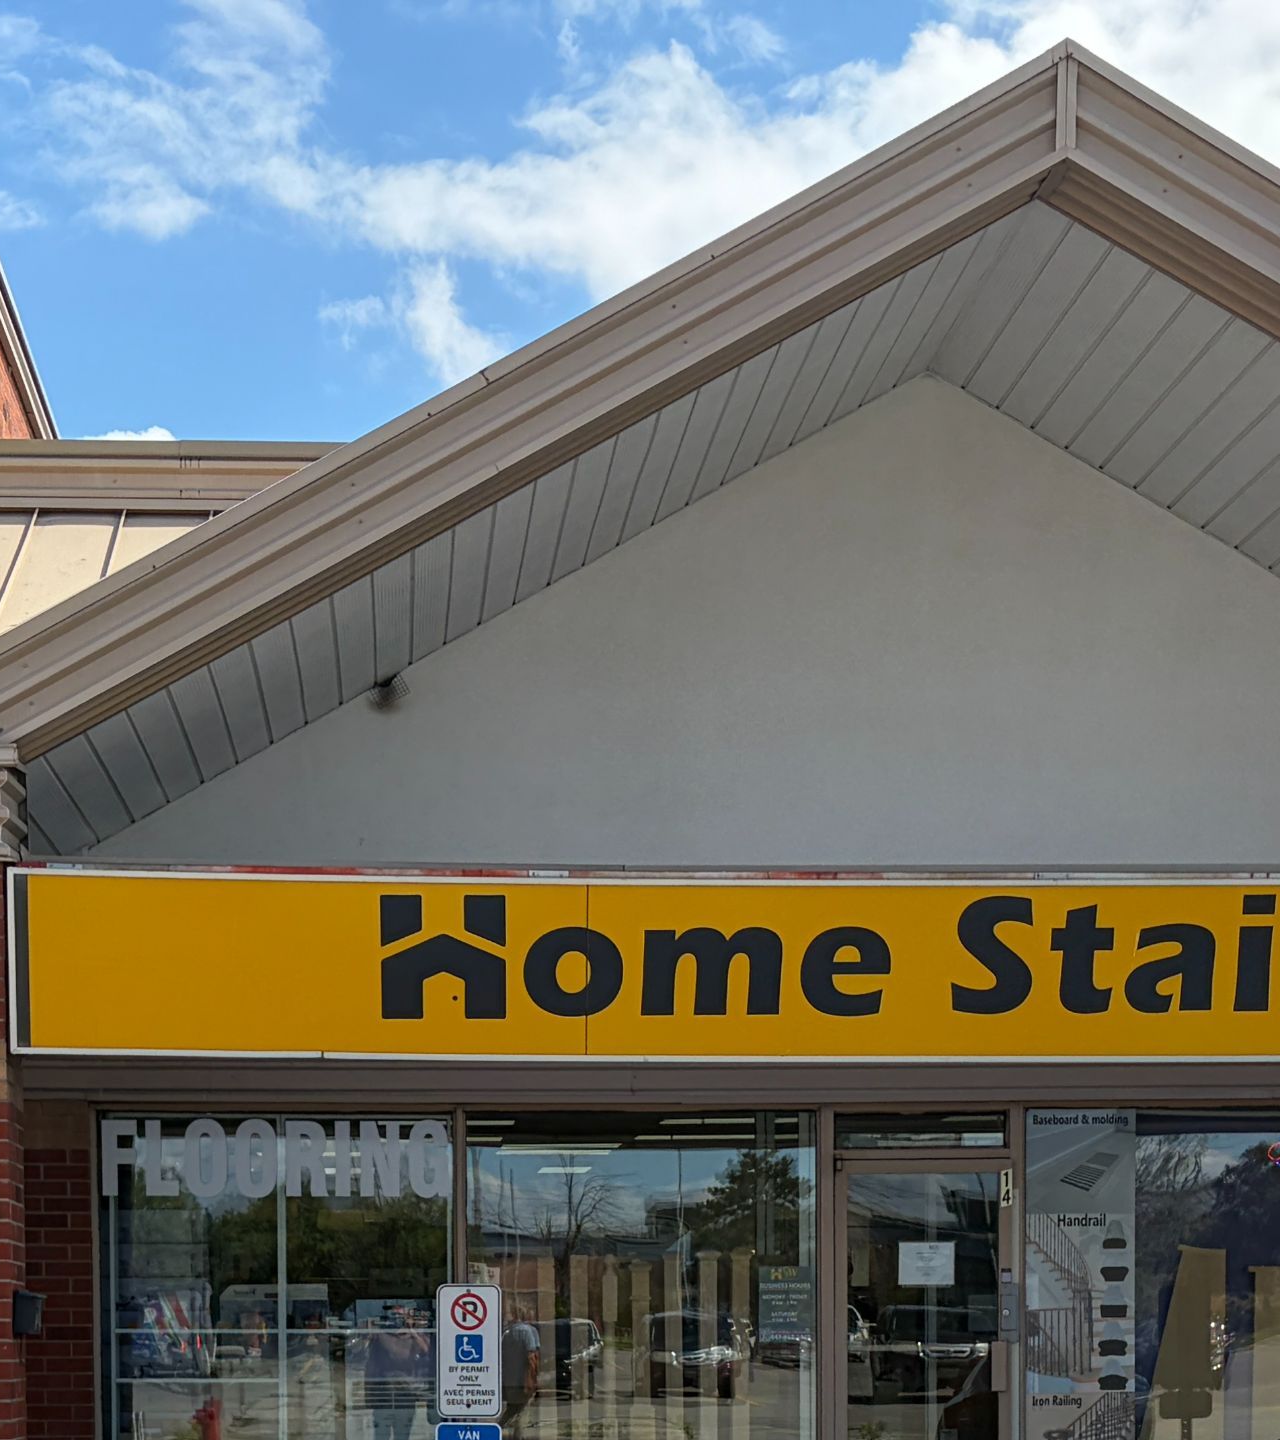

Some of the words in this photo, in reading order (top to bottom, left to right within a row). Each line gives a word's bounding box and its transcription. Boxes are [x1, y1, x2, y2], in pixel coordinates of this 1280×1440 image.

[380, 894, 891, 1020] Home
[1033, 1114, 1079, 1125] Baseboard
[1082, 1114, 1090, 1125] &
[1092, 1114, 1129, 1126] molding
[101, 1118, 453, 1199] FLOORING
[1057, 1213, 1107, 1227] Handrail
[460, 1365, 490, 1373] PERMIT
[443, 1389, 464, 1397] AVEC
[465, 1389, 496, 1397] PERMIS
[446, 1398, 493, 1406] SEULEMENT
[1032, 1396, 1051, 1406] Iron
[1052, 1395, 1082, 1408] Railing
[458, 1430, 481, 1440] VAN
